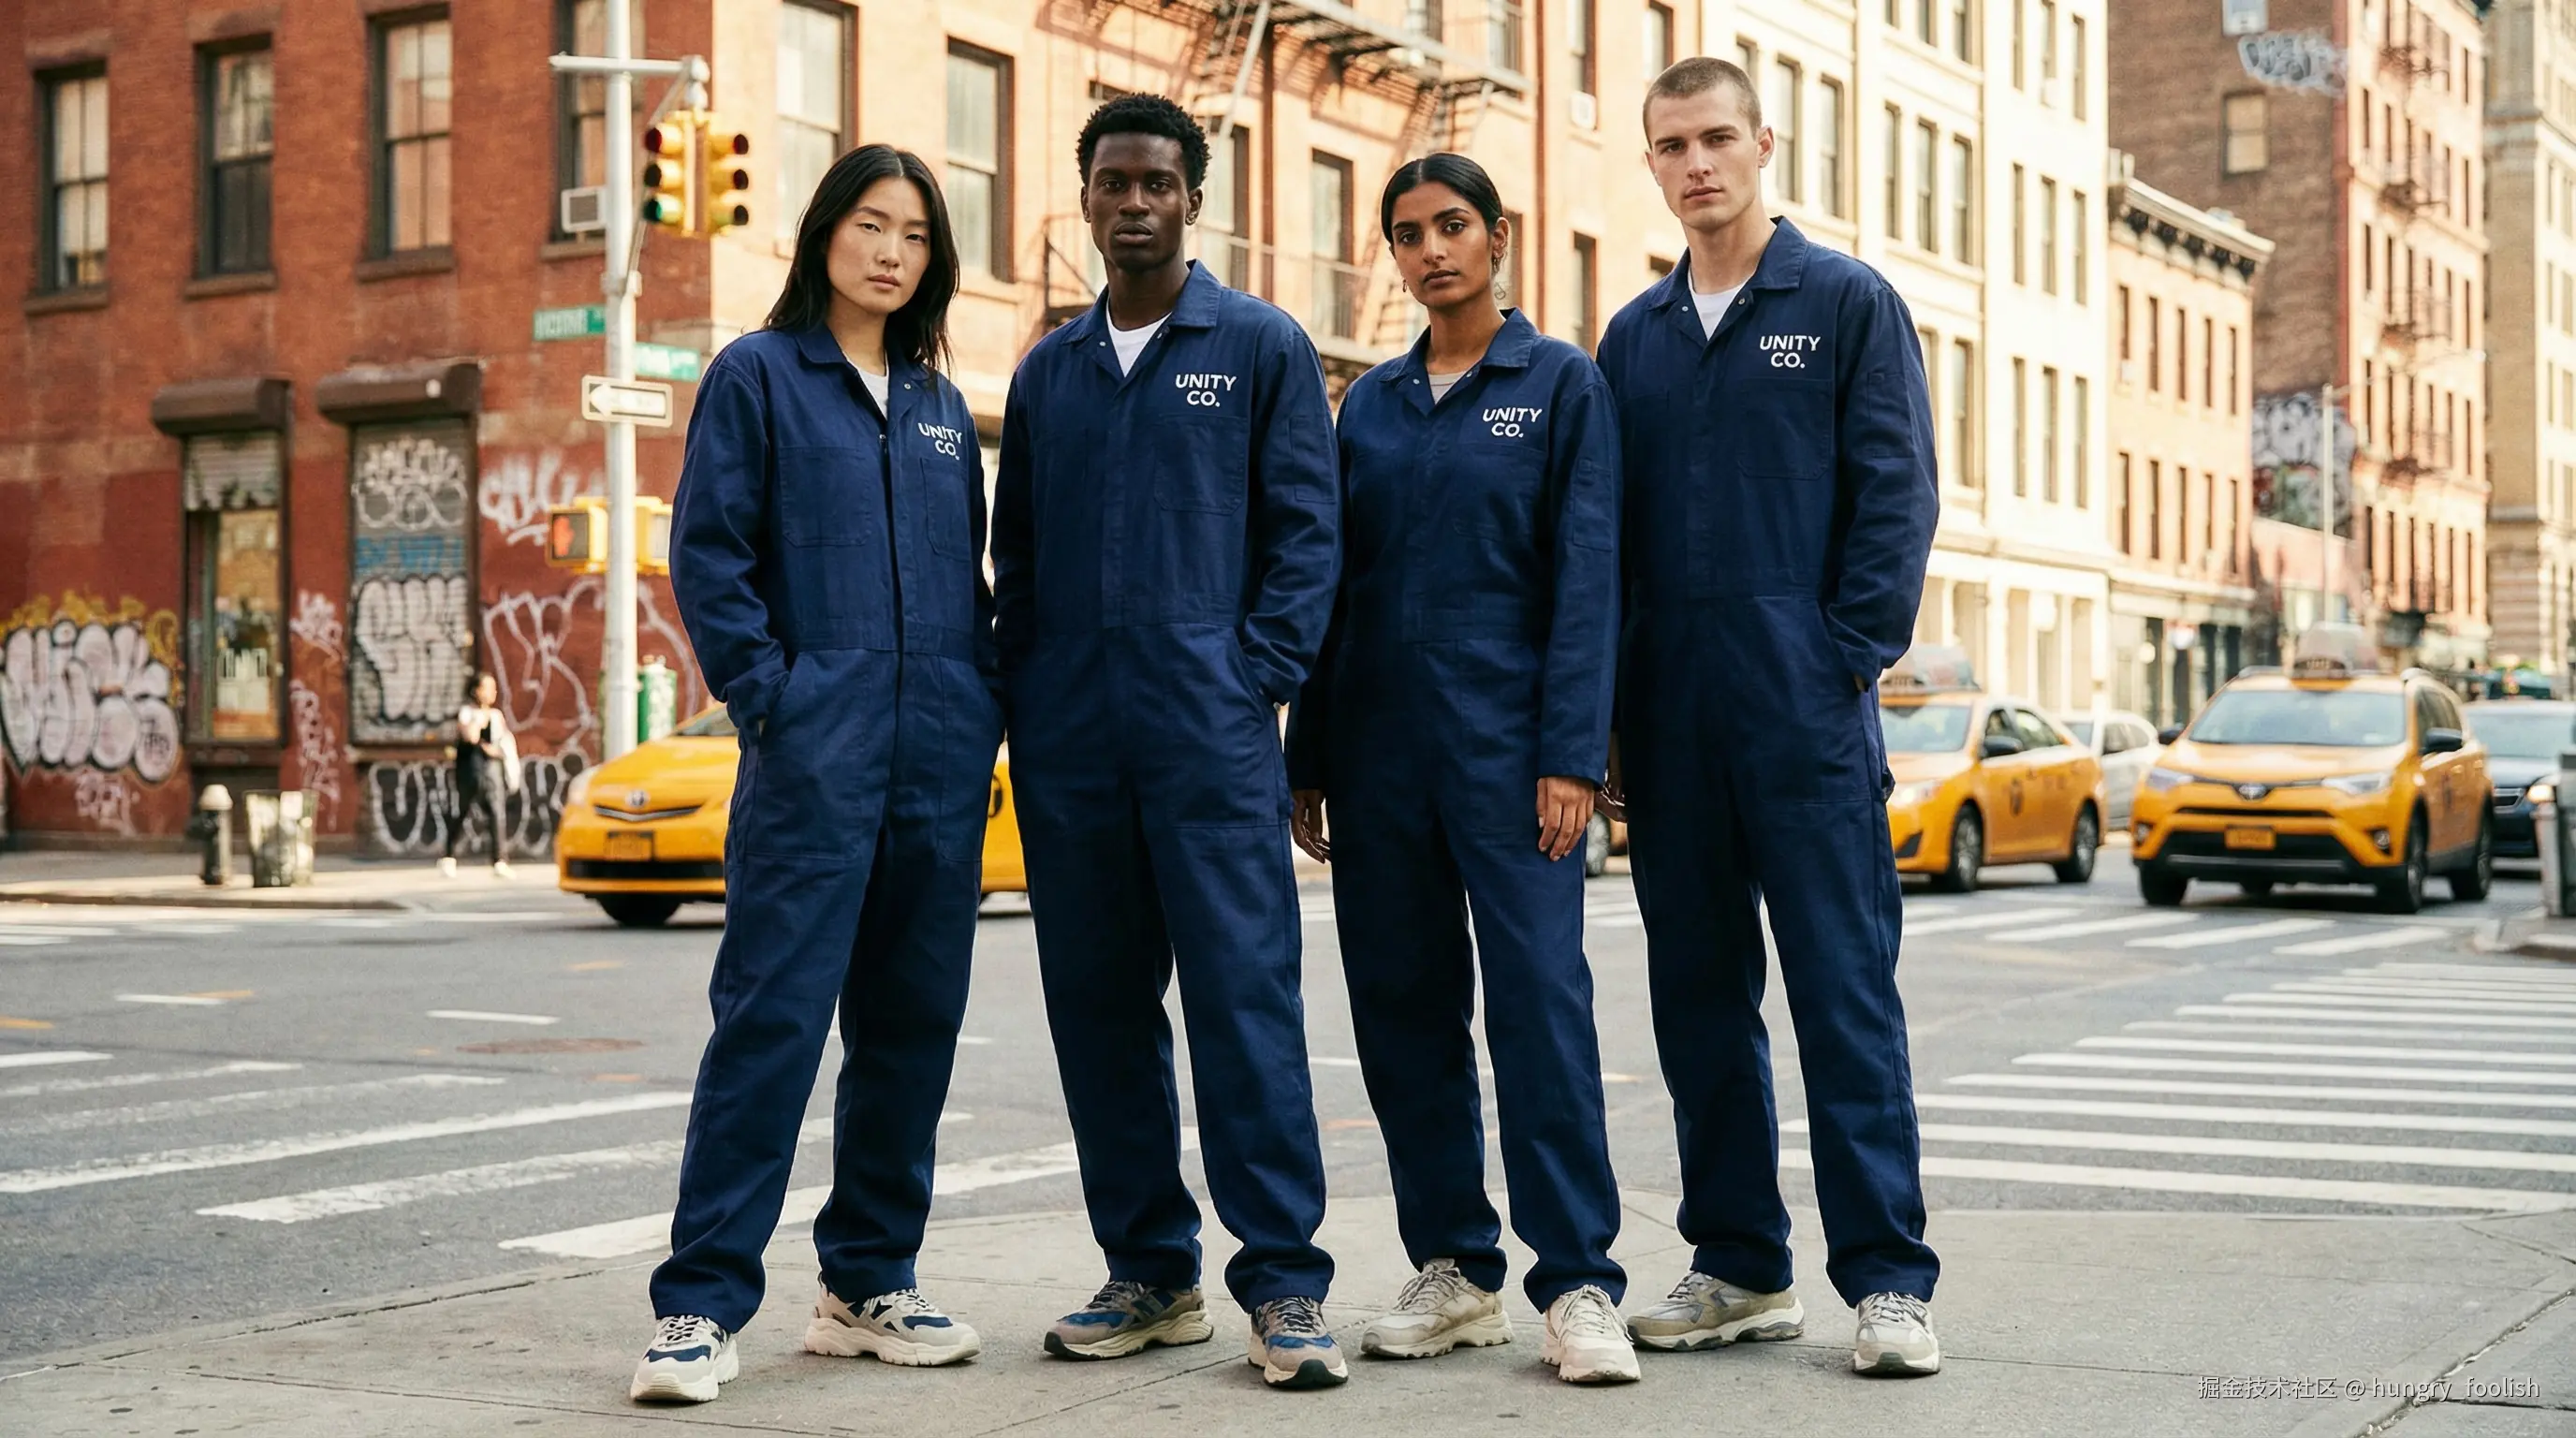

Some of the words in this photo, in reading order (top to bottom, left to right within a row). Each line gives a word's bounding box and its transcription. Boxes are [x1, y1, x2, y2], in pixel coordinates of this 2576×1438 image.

[1760, 335, 1821, 351] UNITY
[1771, 352, 1806, 369] CO.
[1176, 374, 1237, 391] UNITY
[1187, 390, 1221, 407] CO.
[1482, 407, 1543, 423] UNITY
[917, 422, 962, 444] UNITY
[1491, 422, 1524, 438] CO.
[934, 439, 960, 461] CO.
